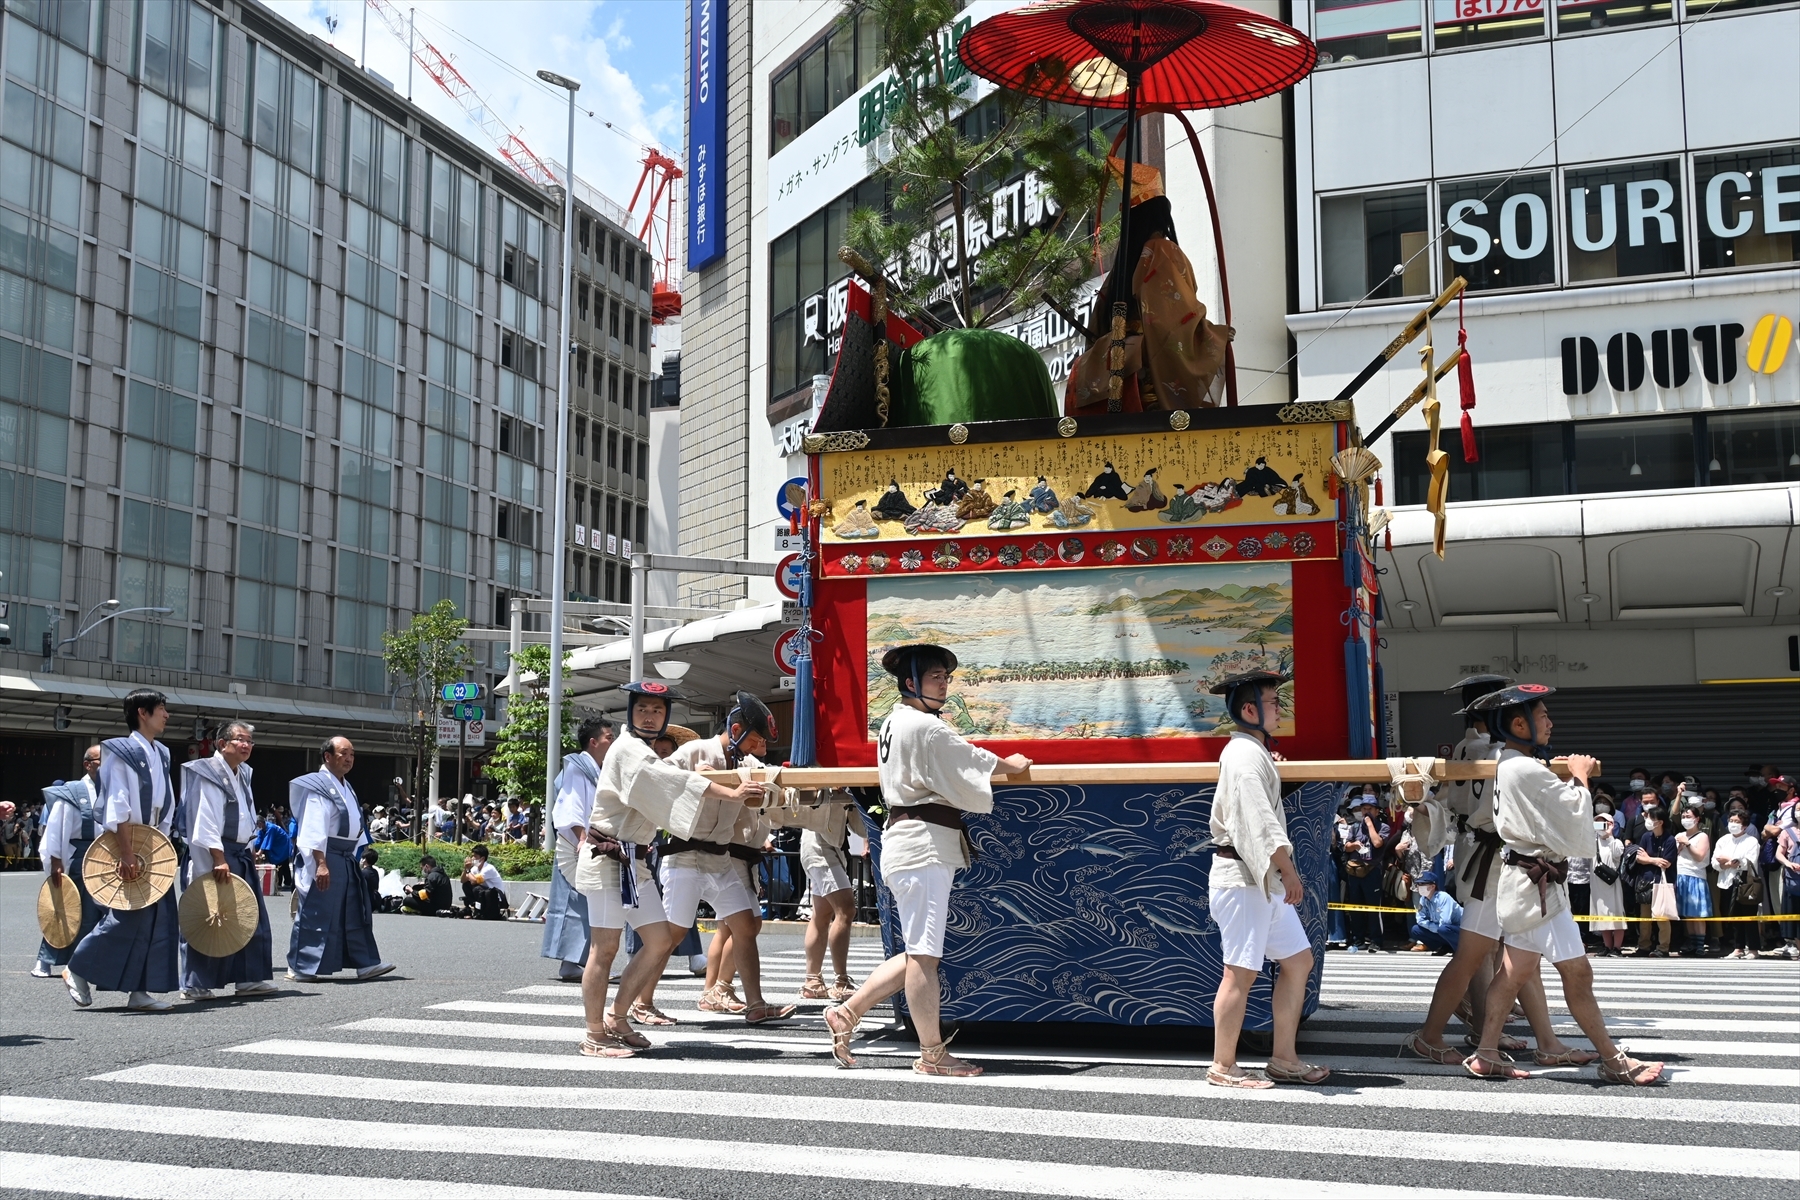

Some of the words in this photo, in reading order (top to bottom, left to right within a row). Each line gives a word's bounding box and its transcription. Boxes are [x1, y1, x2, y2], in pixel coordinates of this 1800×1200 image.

[699, 0, 710, 104] MIZUHO
[697, 143, 707, 246] みずほ銀行
[778, 130, 859, 201] メガネ・サングラス
[1446, 164, 1800, 264] SOURCE
[1561, 313, 1800, 396] DOUTO
[576, 527, 631, 557] 大和証券
[456, 687, 464, 697] 32
